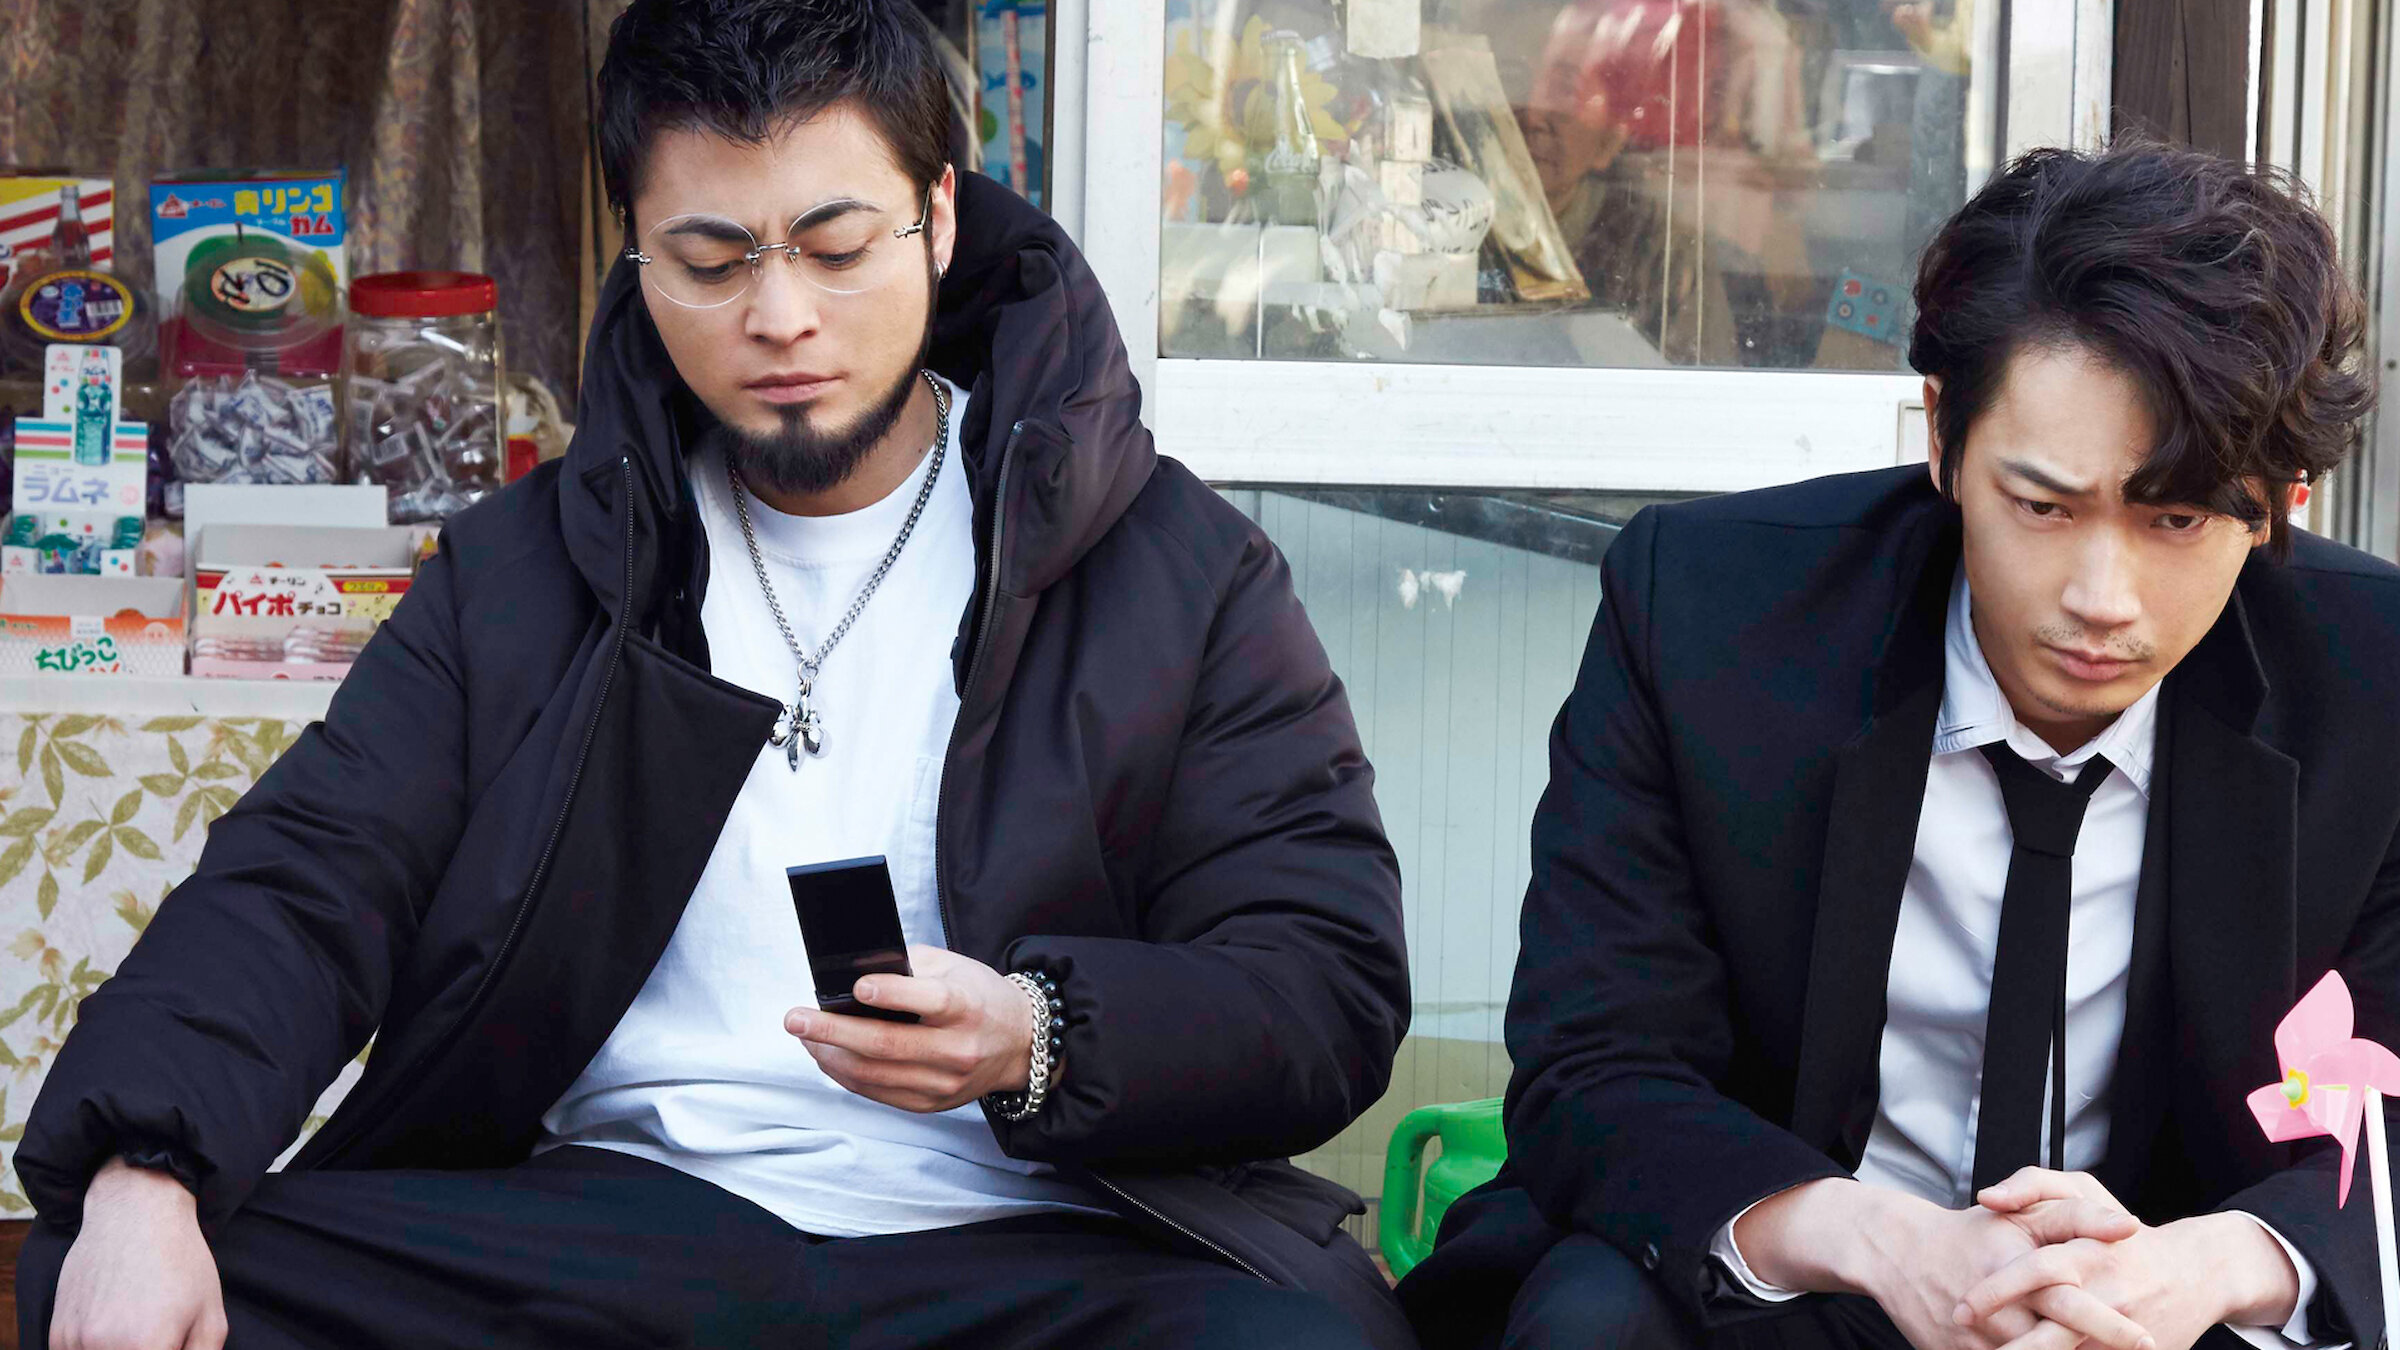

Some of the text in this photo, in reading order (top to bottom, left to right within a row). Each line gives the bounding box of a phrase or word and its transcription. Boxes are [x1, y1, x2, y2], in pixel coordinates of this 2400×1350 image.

[23, 476, 110, 504] ラムネ
[212, 590, 341, 616] パイポ チョコ
[35, 637, 118, 671] ちびっこ
